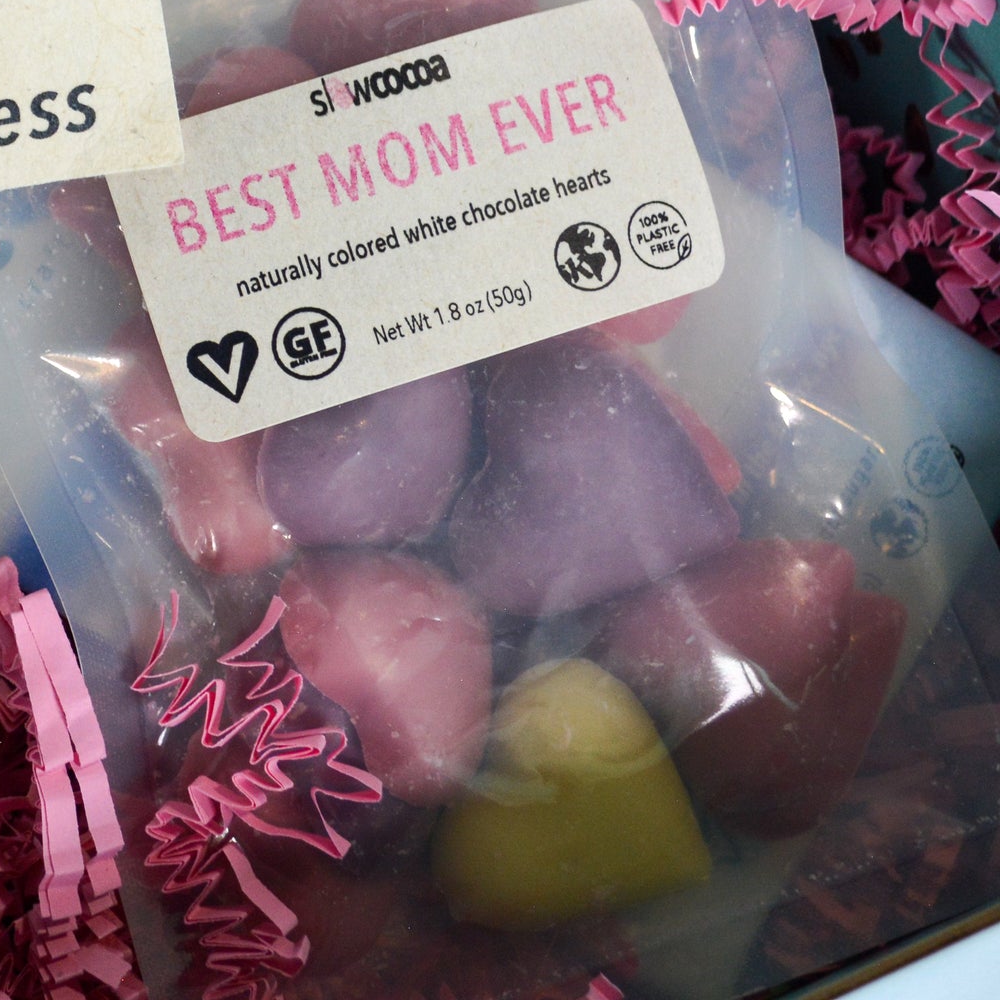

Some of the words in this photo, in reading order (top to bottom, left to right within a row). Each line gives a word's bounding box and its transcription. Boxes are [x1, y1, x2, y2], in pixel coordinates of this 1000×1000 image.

[166, 163, 302, 255] BEST
[318, 113, 477, 207] MOM
[488, 73, 627, 155] EVER
[236, 253, 322, 297] naturally
[328, 226, 400, 268] colored
[403, 216, 457, 245] white
[462, 186, 550, 226] chocolate
[552, 168, 611, 198] hearts
[636, 223, 680, 244] PLASTIC
[638, 211, 669, 228] 100%
[650, 240, 676, 255] FREE
[373, 322, 405, 345] Net
[404, 312, 432, 334] Wt
[433, 303, 461, 325] 1.8
[465, 300, 484, 316] oz
[486, 280, 532, 313] (50g)
[283, 319, 332, 359] GF
